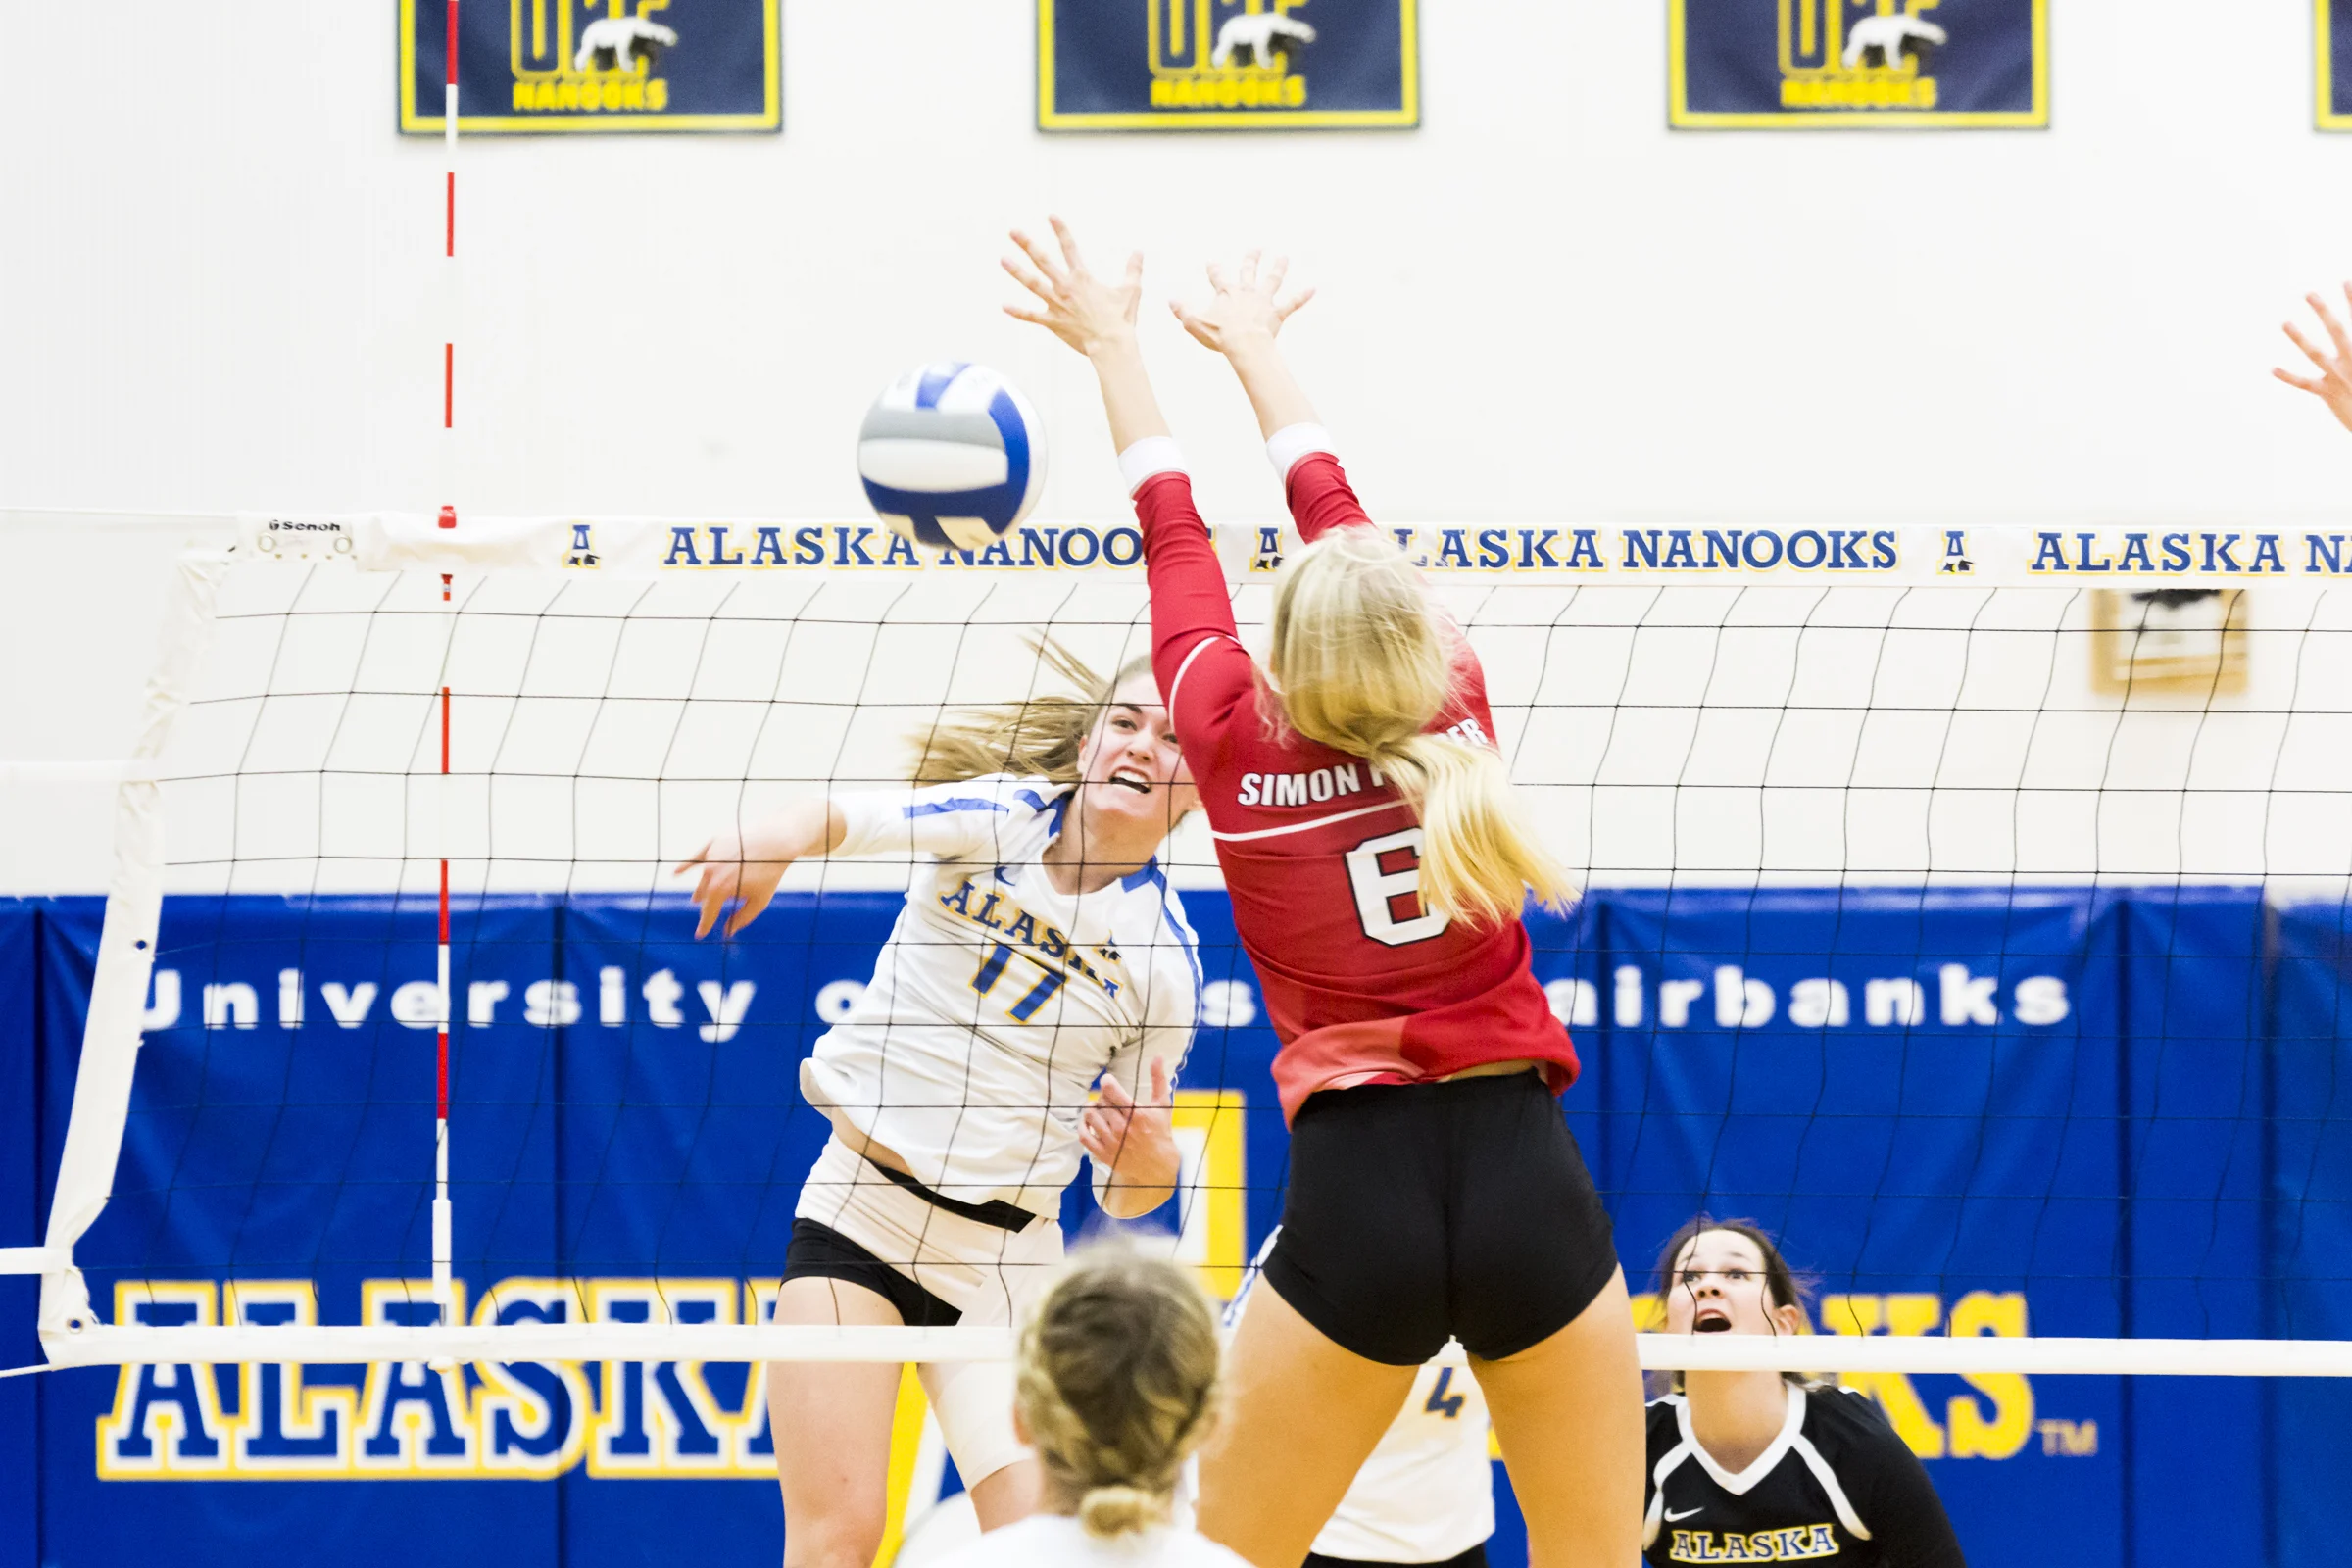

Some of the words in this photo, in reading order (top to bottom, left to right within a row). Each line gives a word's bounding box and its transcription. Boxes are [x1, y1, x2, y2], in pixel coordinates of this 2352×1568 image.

[663, 526, 919, 566] ALASKA
[938, 527, 1212, 566] ANOO
[1393, 528, 1604, 568] LASKA
[1622, 529, 1897, 569] NANOOKS
[2032, 532, 2285, 573] ALASKA
[2305, 534, 2352, 573] N
[1237, 762, 1362, 807] SIMON
[1344, 826, 1453, 947] 6
[968, 941, 1069, 1024] 17
[1545, 964, 2071, 1028] airbanks
[1425, 1366, 1464, 1418] 4
[2034, 1418, 2098, 1457] TM
[1670, 1524, 1838, 1563] ALASKA
